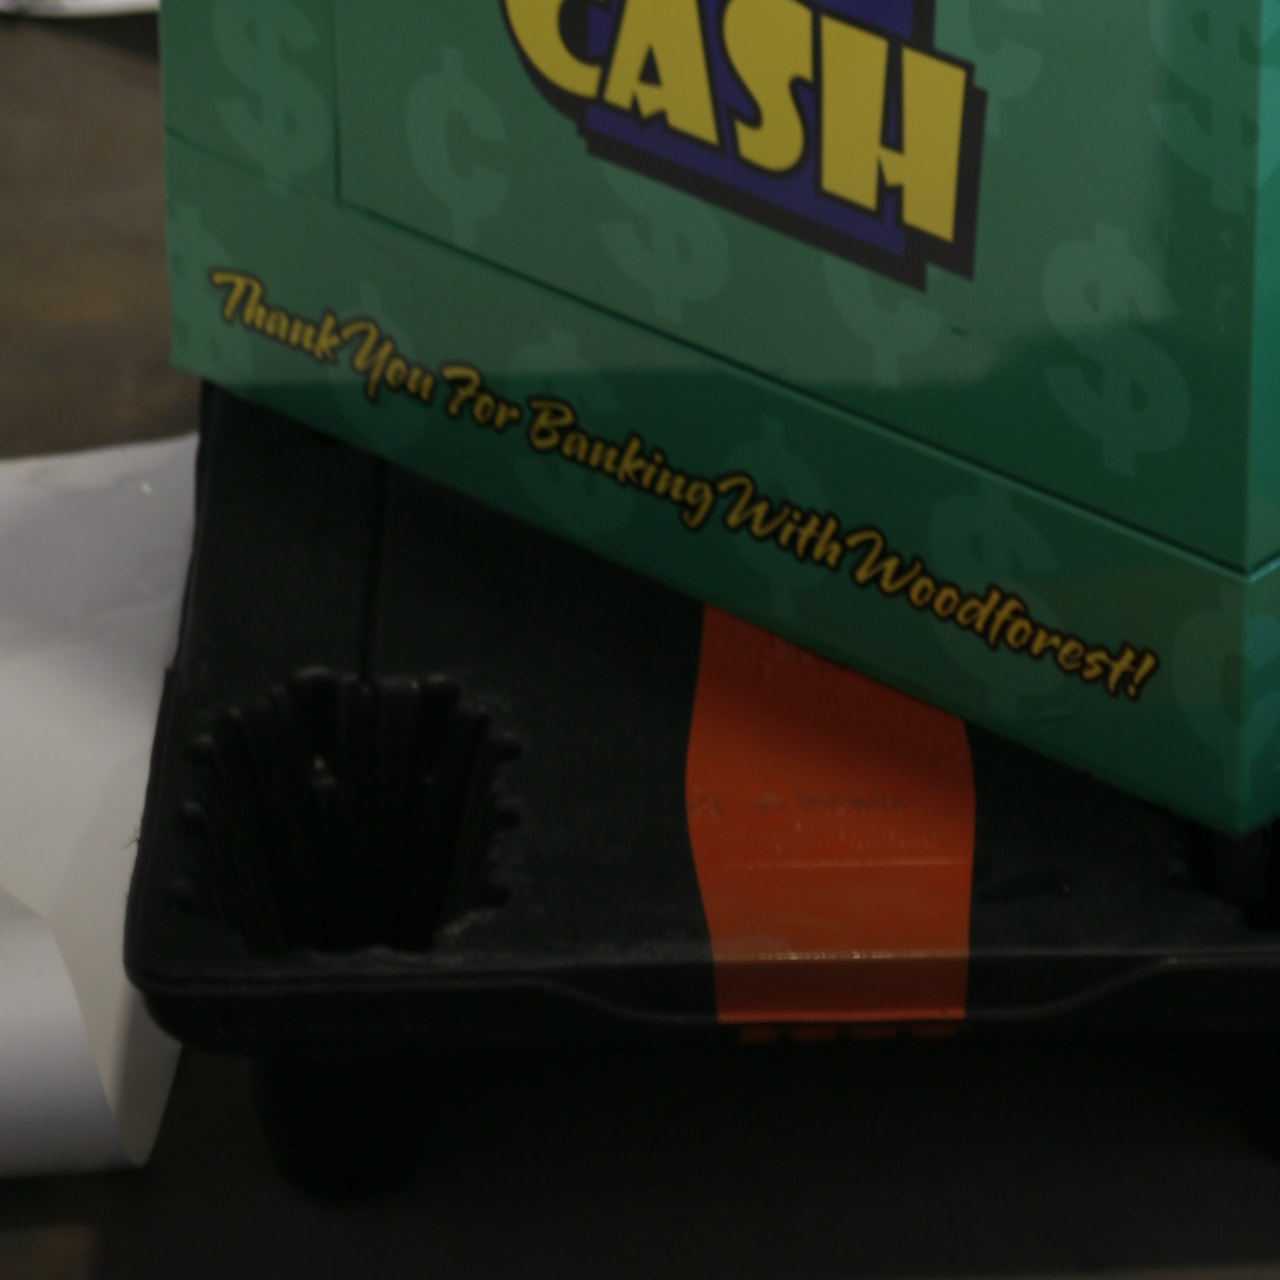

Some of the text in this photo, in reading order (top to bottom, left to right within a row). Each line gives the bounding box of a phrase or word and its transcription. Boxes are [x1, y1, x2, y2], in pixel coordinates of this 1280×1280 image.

[212, 270, 1158, 698] Thank You For Banking With Woodforest!
